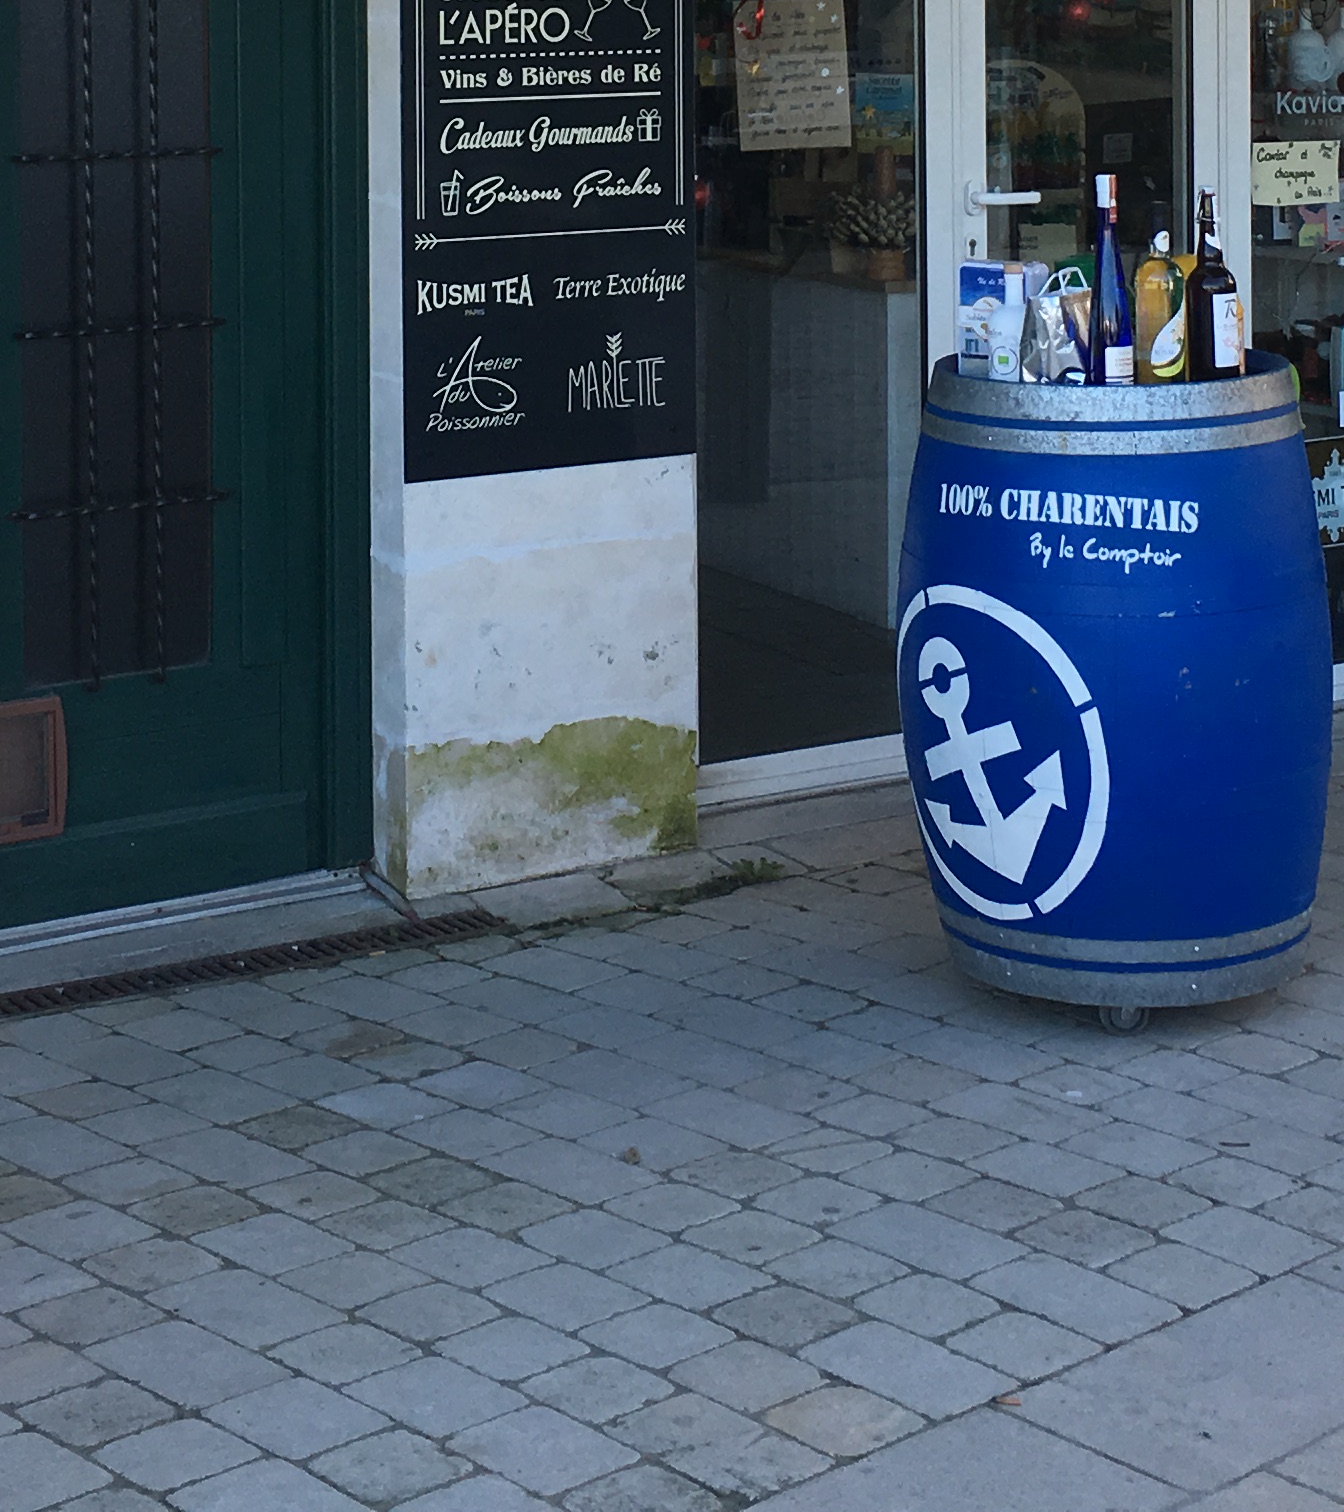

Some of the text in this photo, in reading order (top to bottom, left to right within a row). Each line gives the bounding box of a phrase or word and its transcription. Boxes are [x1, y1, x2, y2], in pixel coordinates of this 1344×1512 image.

[438, 2, 571, 45] L'APÉRO
[439, 61, 662, 89] Vins & Bières de Ré
[439, 115, 635, 155] Cadeaux Gourmands
[465, 166, 662, 216] Boissons Fraîches
[416, 273, 534, 316] KUSMI TEA
[552, 268, 687, 302] Terre Exotique
[447, 385, 471, 405] du
[566, 346, 666, 414] MARLETTE
[425, 411, 526, 432] Poissonnier
[938, 482, 1200, 535] 100% CHARENTAIS
[1029, 531, 1182, 575] By le Comptoir
